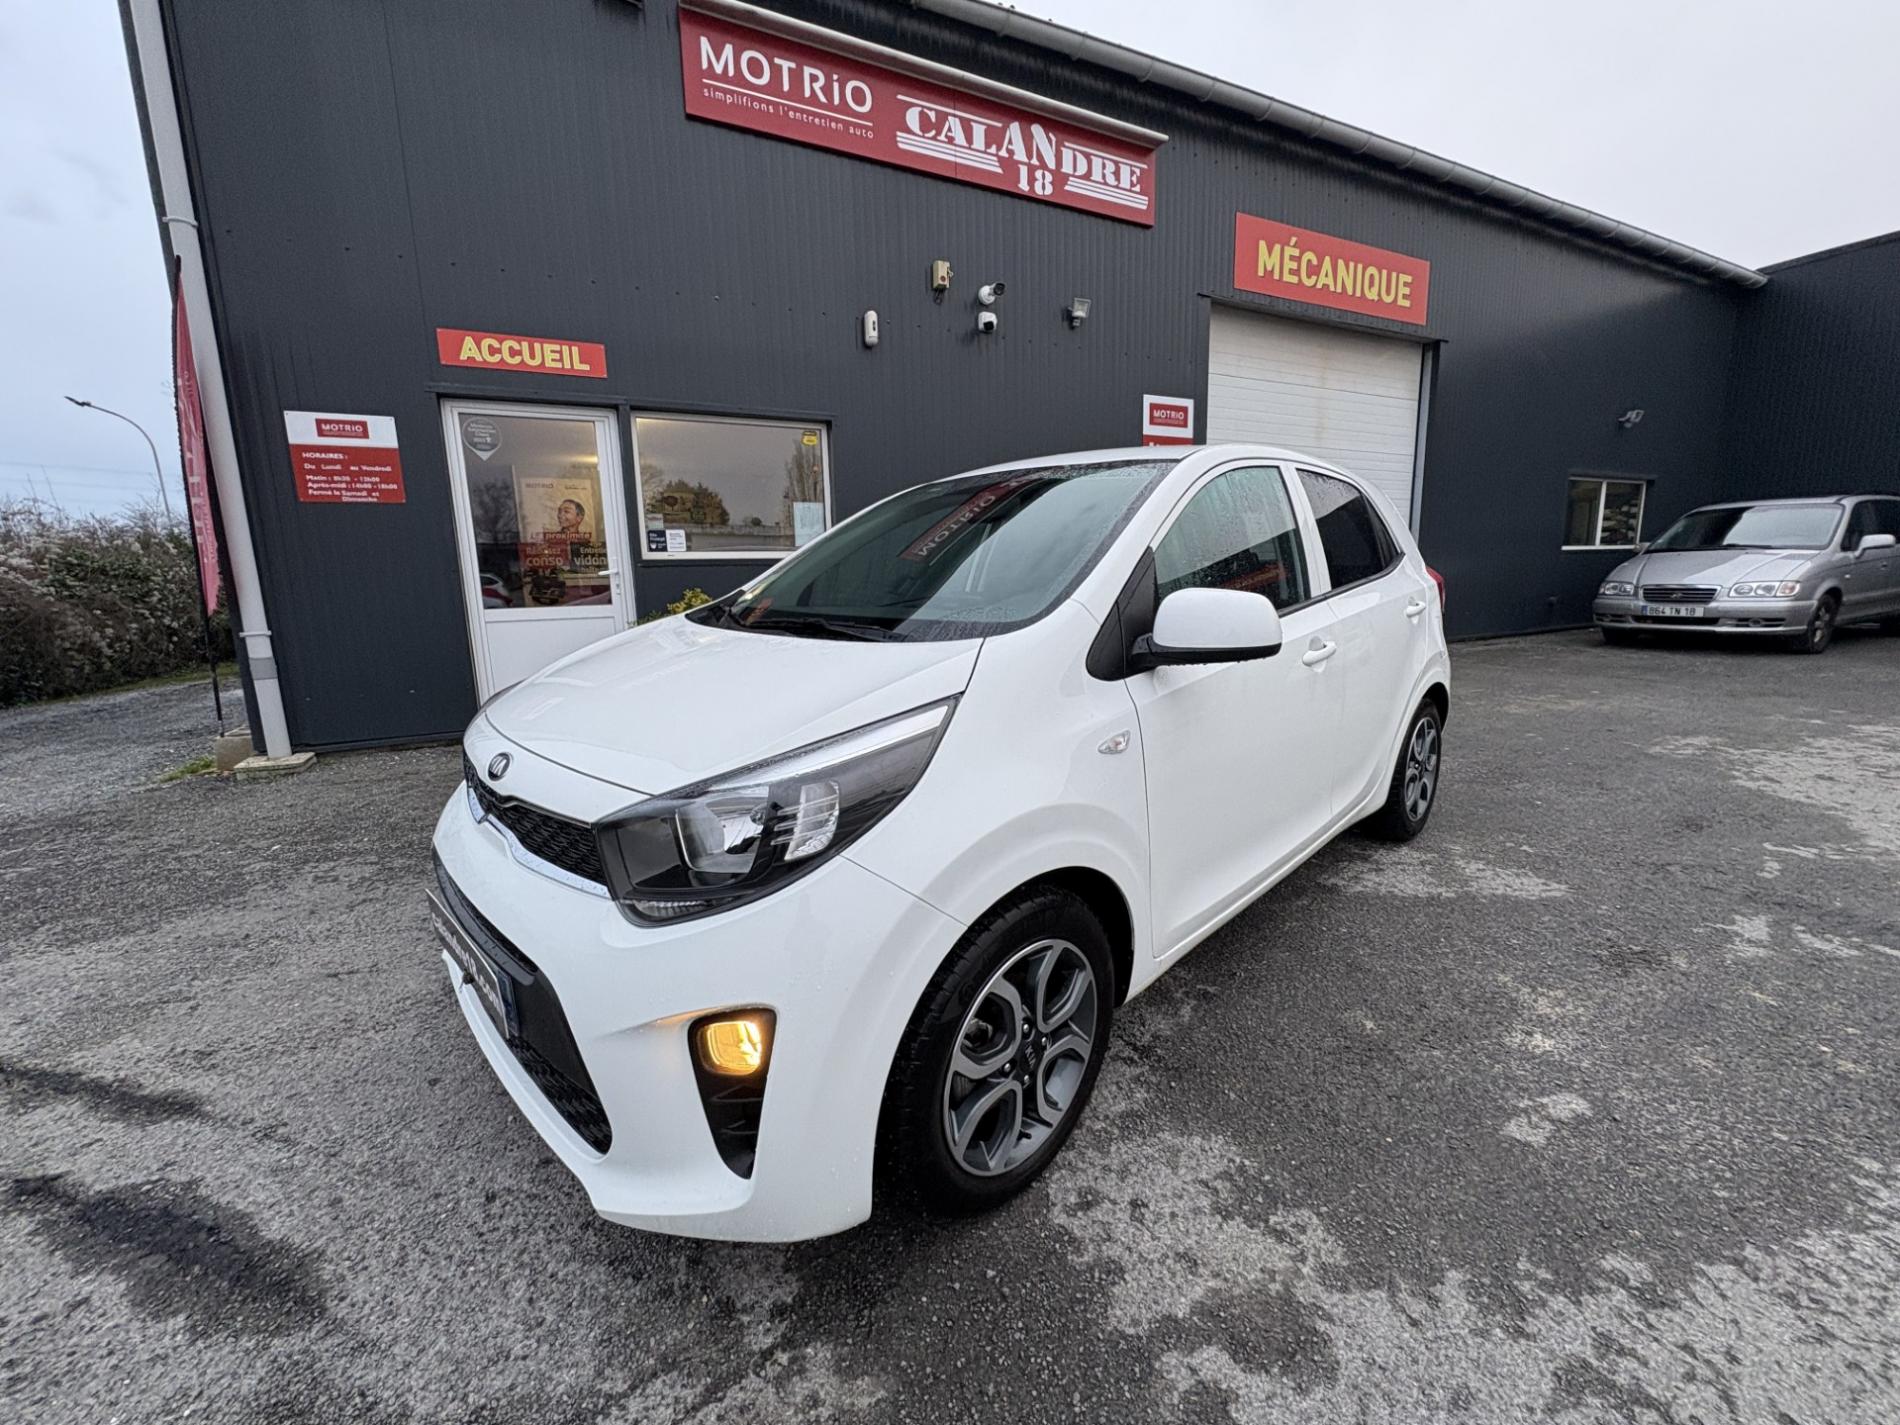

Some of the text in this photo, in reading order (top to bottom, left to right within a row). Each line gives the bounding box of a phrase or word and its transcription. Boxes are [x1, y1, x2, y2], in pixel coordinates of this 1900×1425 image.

[703, 87, 874, 139] simplifions l'entretien auto
[905, 106, 1141, 193] CALANDRE
[1017, 163, 1053, 196] 18
[1257, 236, 1413, 308] MÉCANIQUE
[459, 335, 591, 371] ACCUEIL
[360, 464, 392, 472] Vendredi
[526, 556, 564, 567] conso
